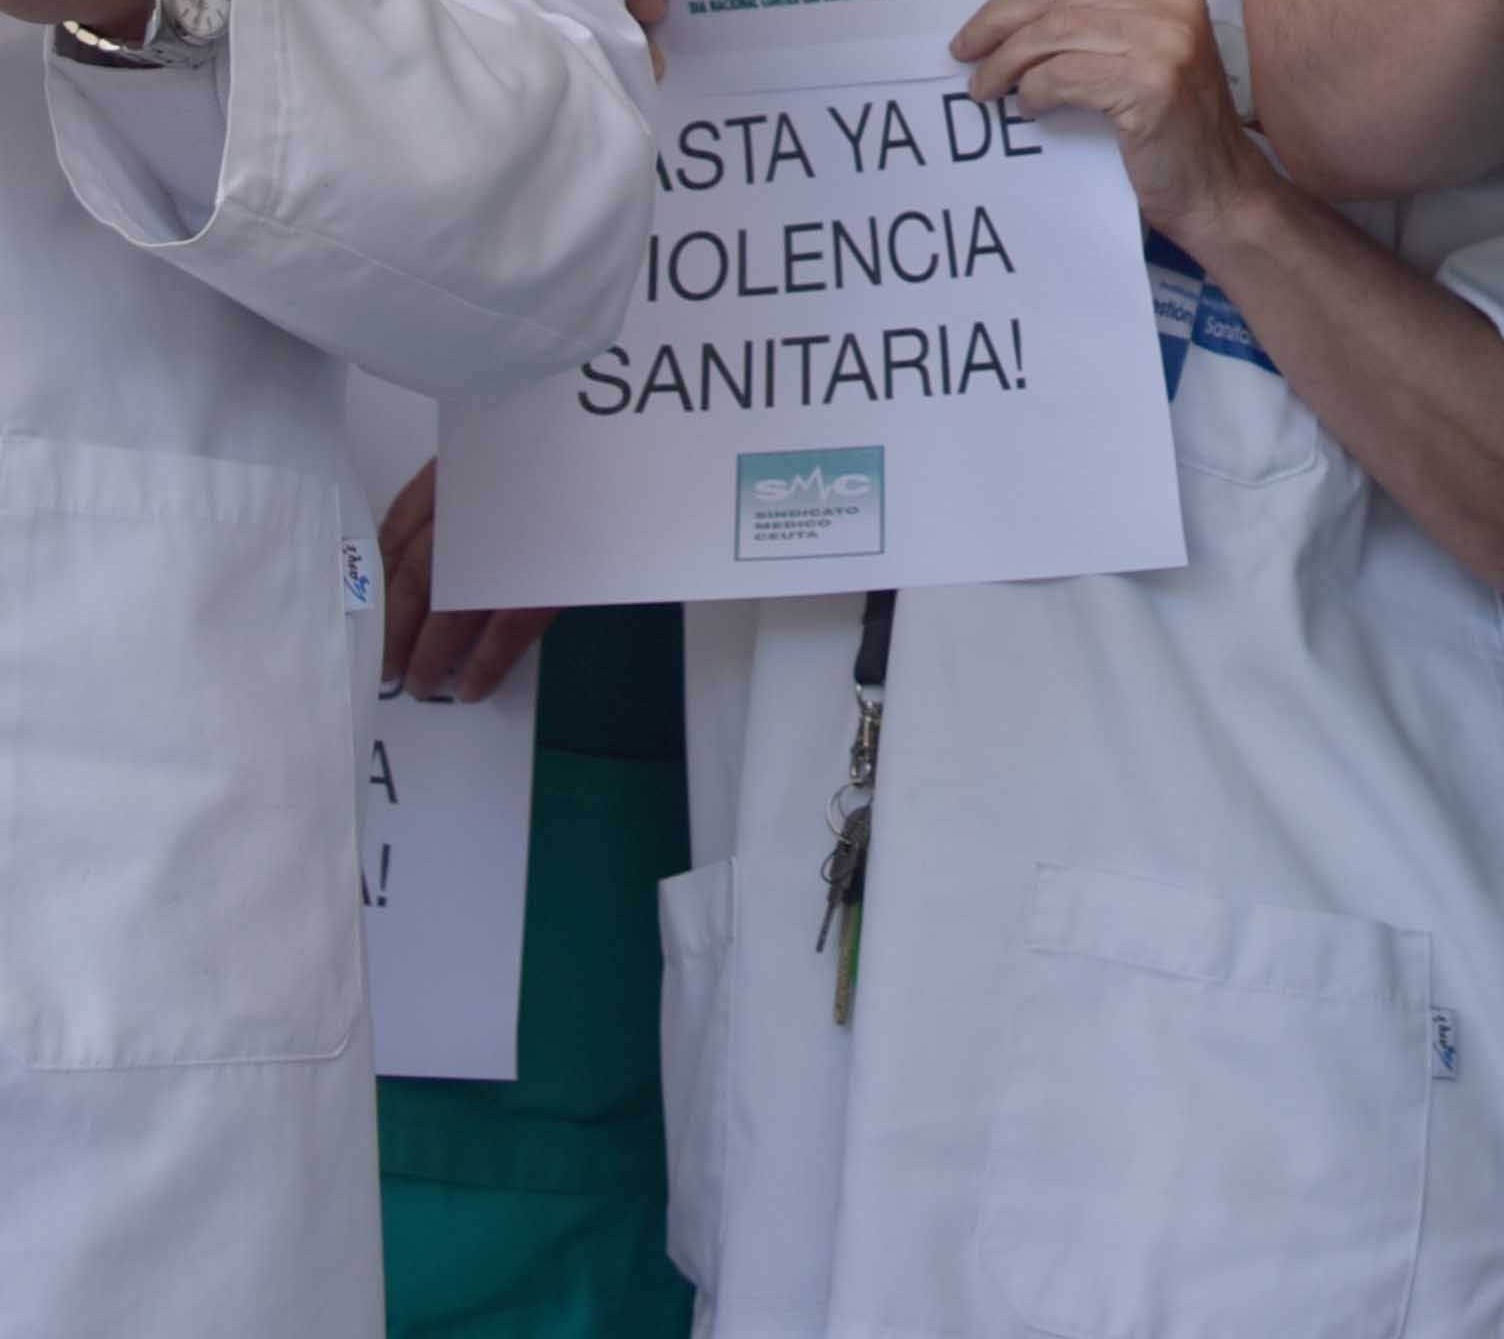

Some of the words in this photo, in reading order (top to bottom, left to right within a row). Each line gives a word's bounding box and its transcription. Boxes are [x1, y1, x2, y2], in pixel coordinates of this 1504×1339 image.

[827, 99, 926, 175] YA
[942, 90, 1043, 163] DE
[647, 206, 1014, 303] IOLENCIA
[577, 320, 1028, 415] SANITARIA!
[753, 530, 819, 541] CEUTA
[754, 506, 859, 519] SINDICATO
[754, 519, 832, 530] MEDICO
